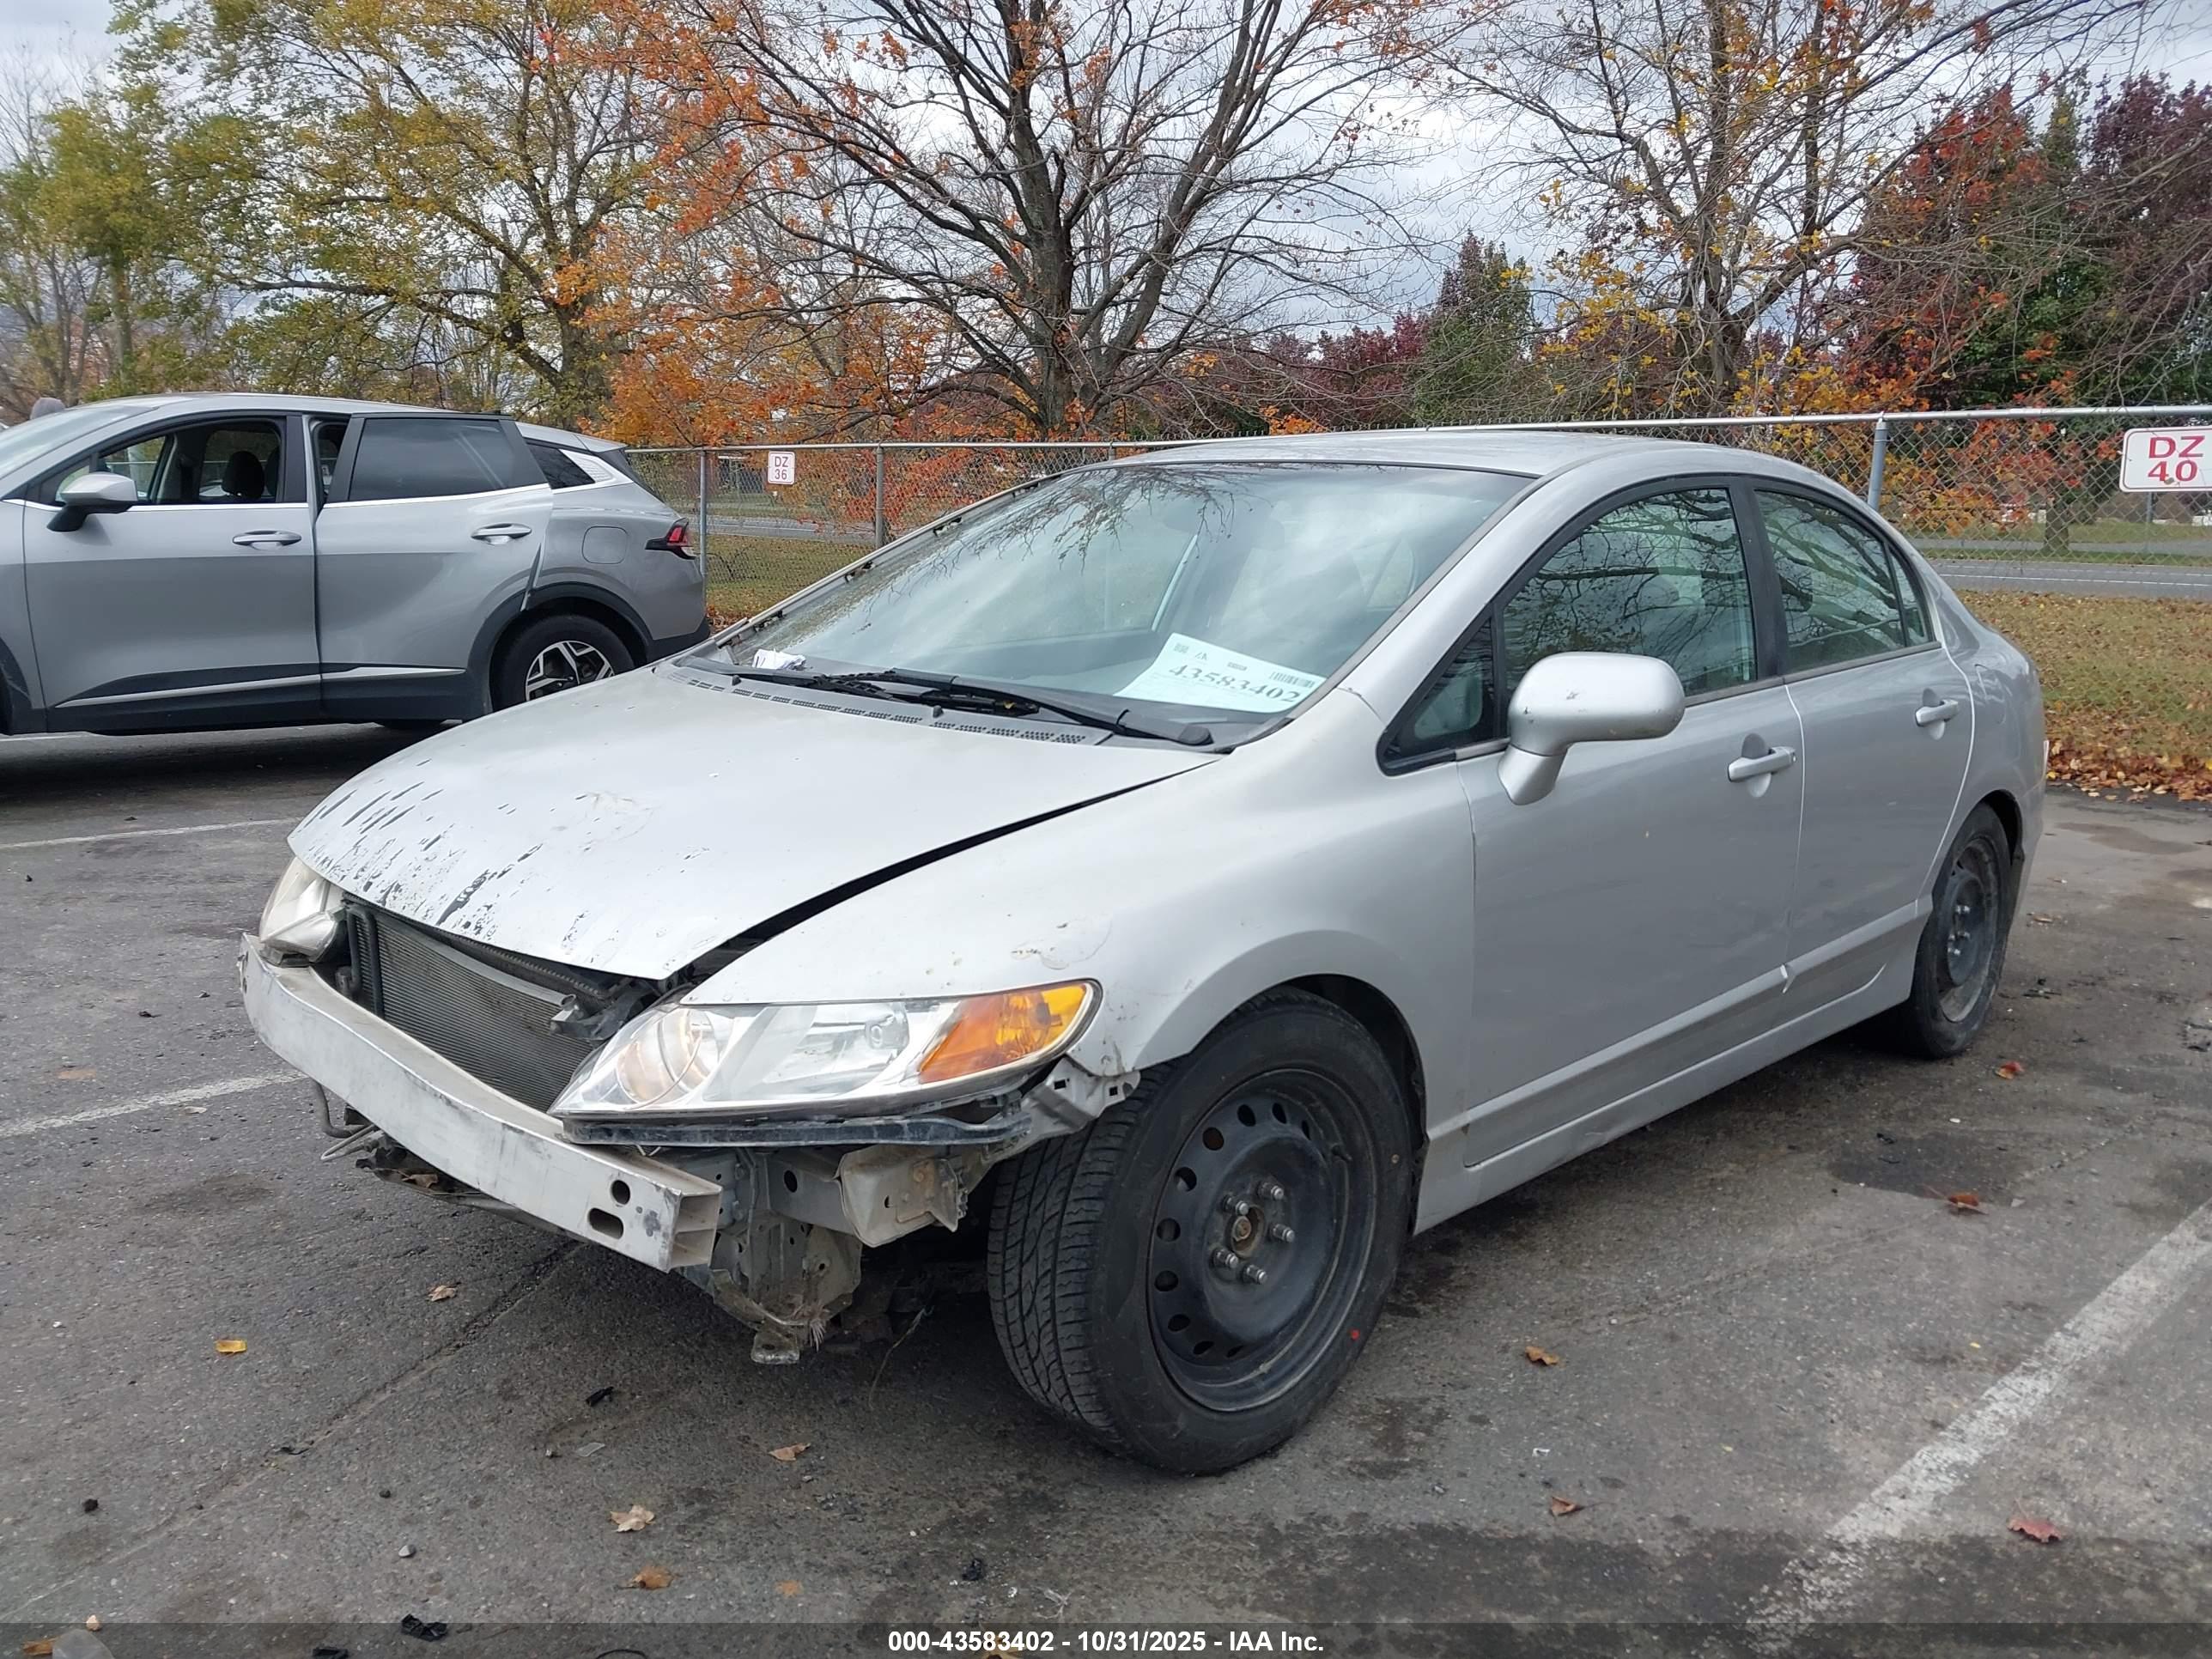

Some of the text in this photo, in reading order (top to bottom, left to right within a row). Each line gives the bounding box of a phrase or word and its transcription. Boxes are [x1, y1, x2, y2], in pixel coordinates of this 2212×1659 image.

[2148, 434, 2206, 459] DZ
[775, 456, 789, 468] DZ
[2147, 460, 2198, 482] 40
[775, 468, 787, 480] 36
[1168, 664, 1301, 702] 43583402
